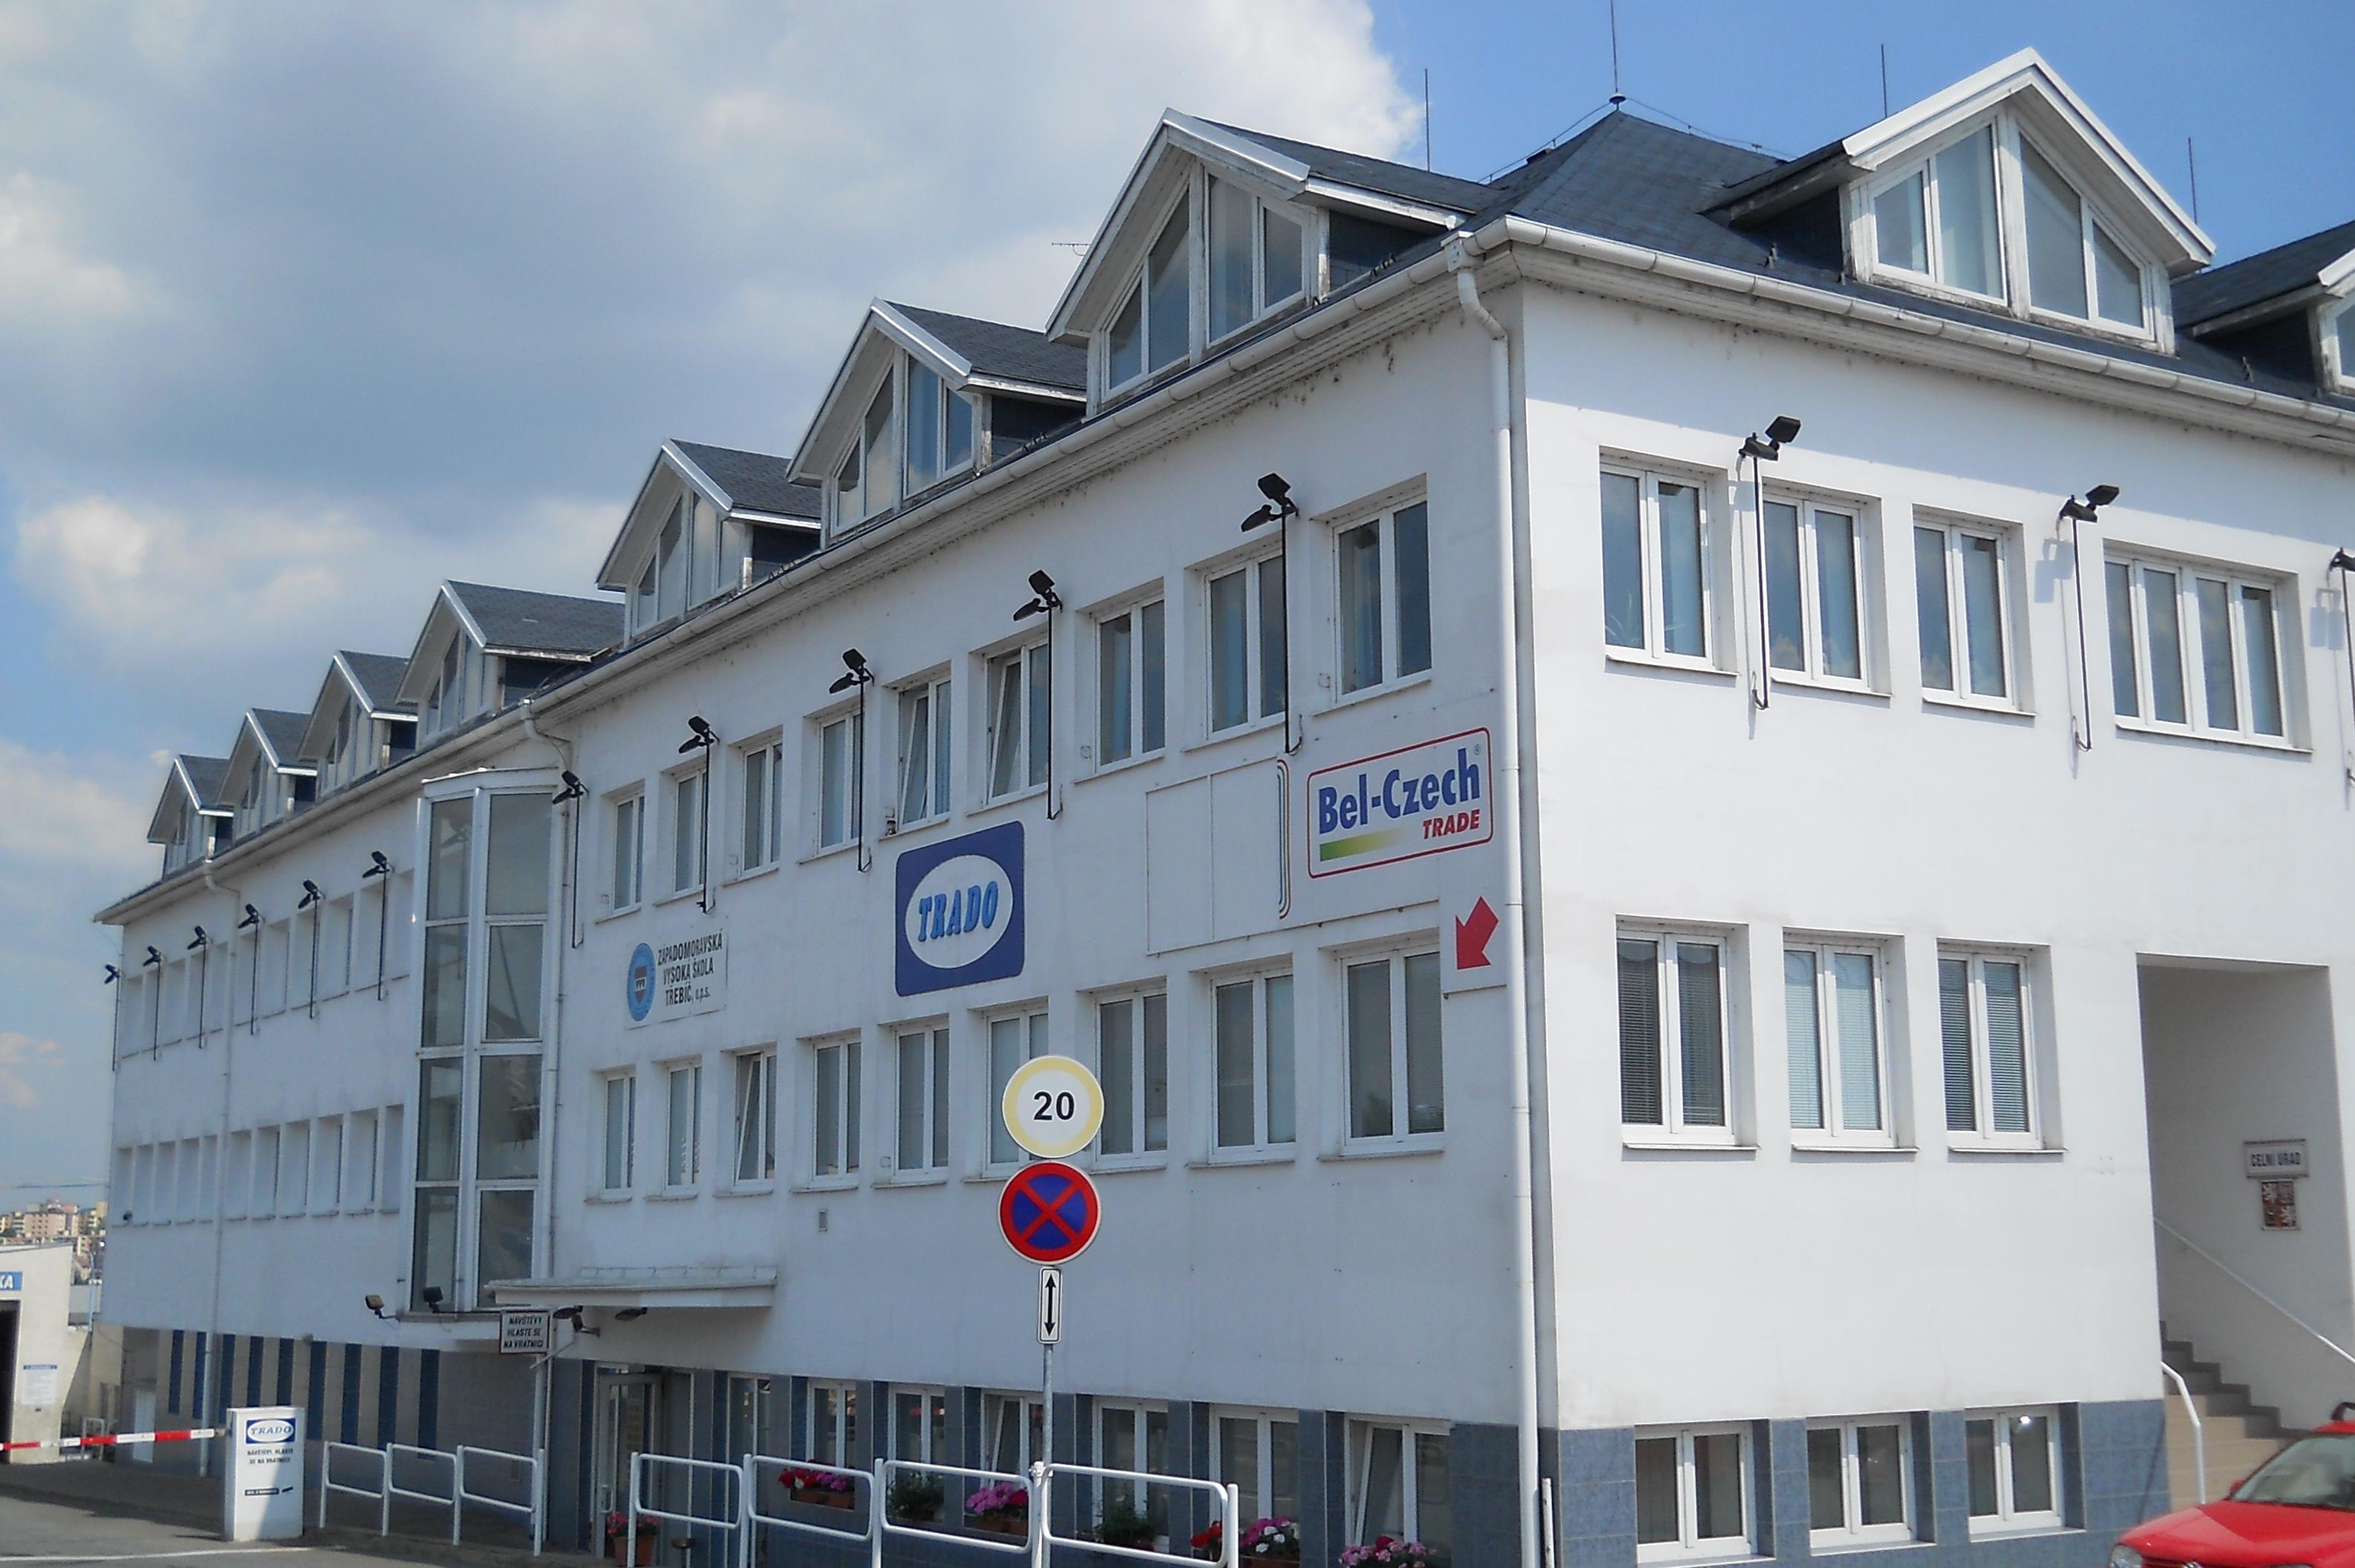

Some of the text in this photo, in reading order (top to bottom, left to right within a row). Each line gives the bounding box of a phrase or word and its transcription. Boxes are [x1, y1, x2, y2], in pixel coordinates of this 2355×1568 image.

[1318, 748, 1480, 834] Bel-Czech
[1423, 809, 1480, 840] TRADE
[918, 880, 999, 943] TRADO
[658, 928, 723, 966] ZÁPADOMORAVSKÁ
[663, 957, 714, 985] VYSOKÁ ŠKOLA
[1032, 1091, 1076, 1121] 20
[251, 1426, 292, 1434] TRADO
